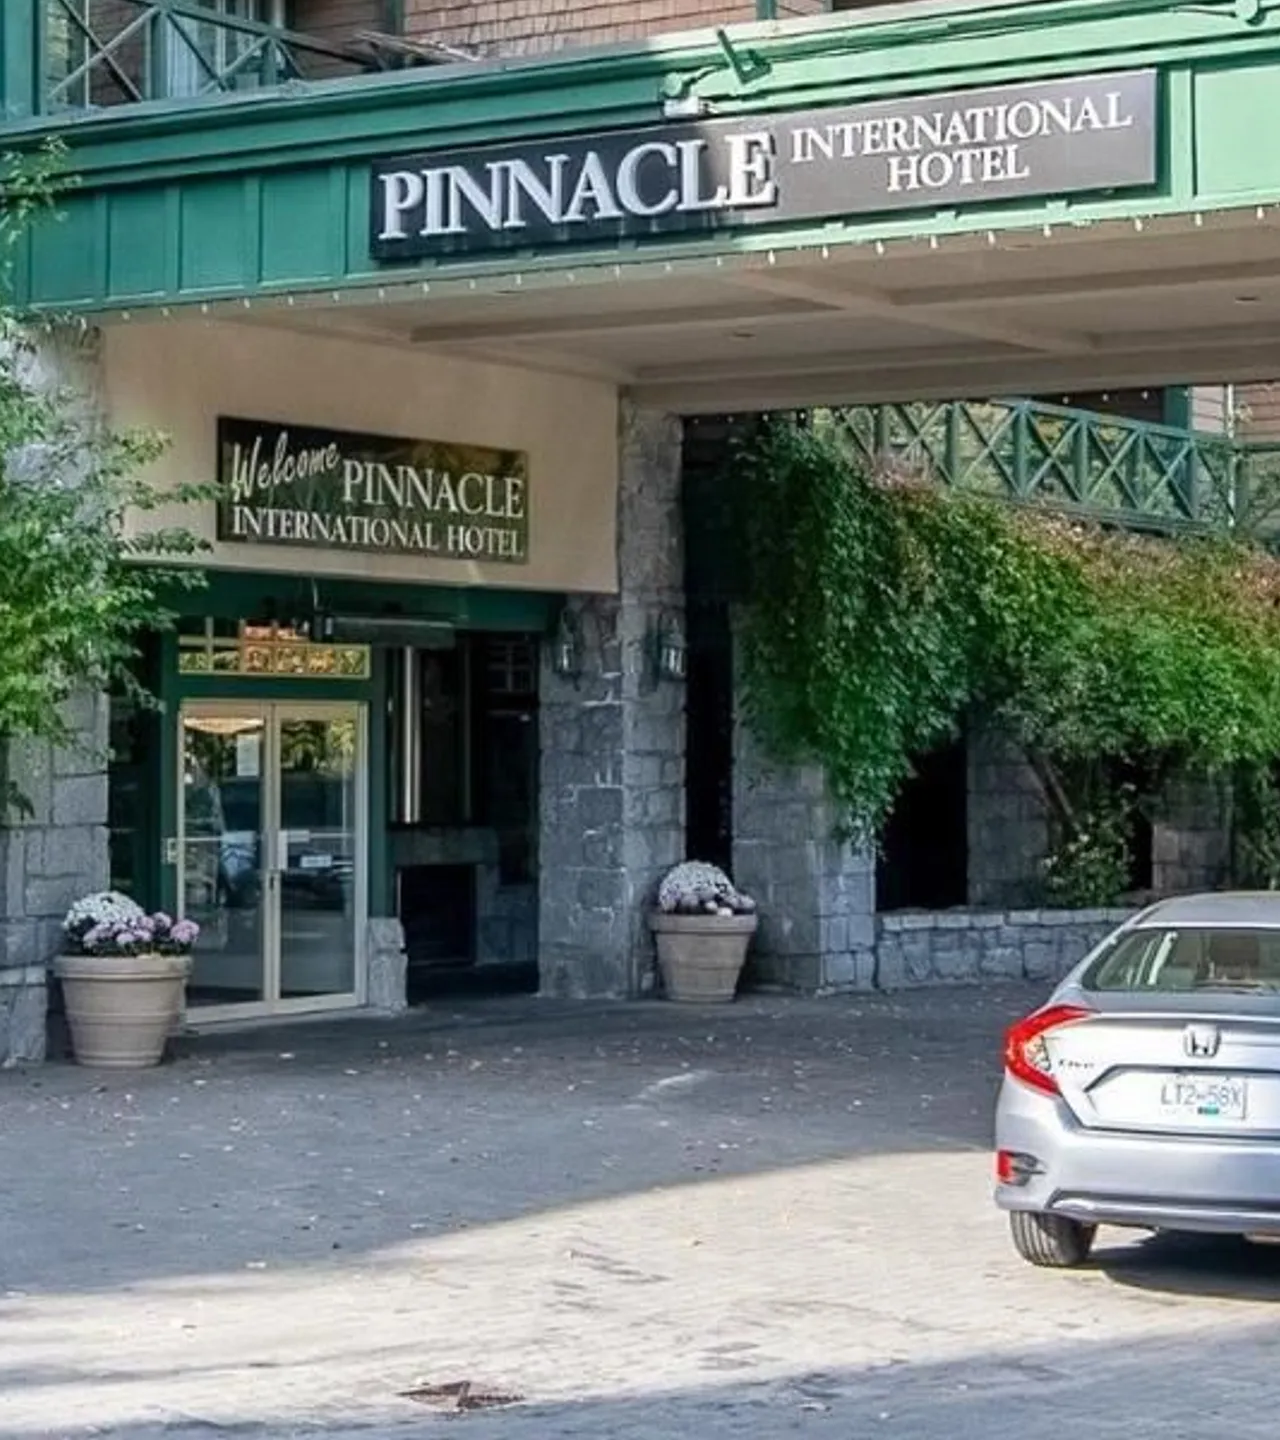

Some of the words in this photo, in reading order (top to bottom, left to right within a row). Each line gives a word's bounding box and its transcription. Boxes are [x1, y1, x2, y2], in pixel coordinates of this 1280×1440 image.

[789, 91, 1133, 162] INTERNATIONAL
[377, 130, 779, 241] PINNACLE
[886, 144, 1030, 193] HOTEL
[231, 430, 341, 503] Welcome
[342, 458, 524, 518] PINNACLE
[232, 505, 439, 551] INTERNATIONAL
[447, 526, 524, 557] HOTEL
